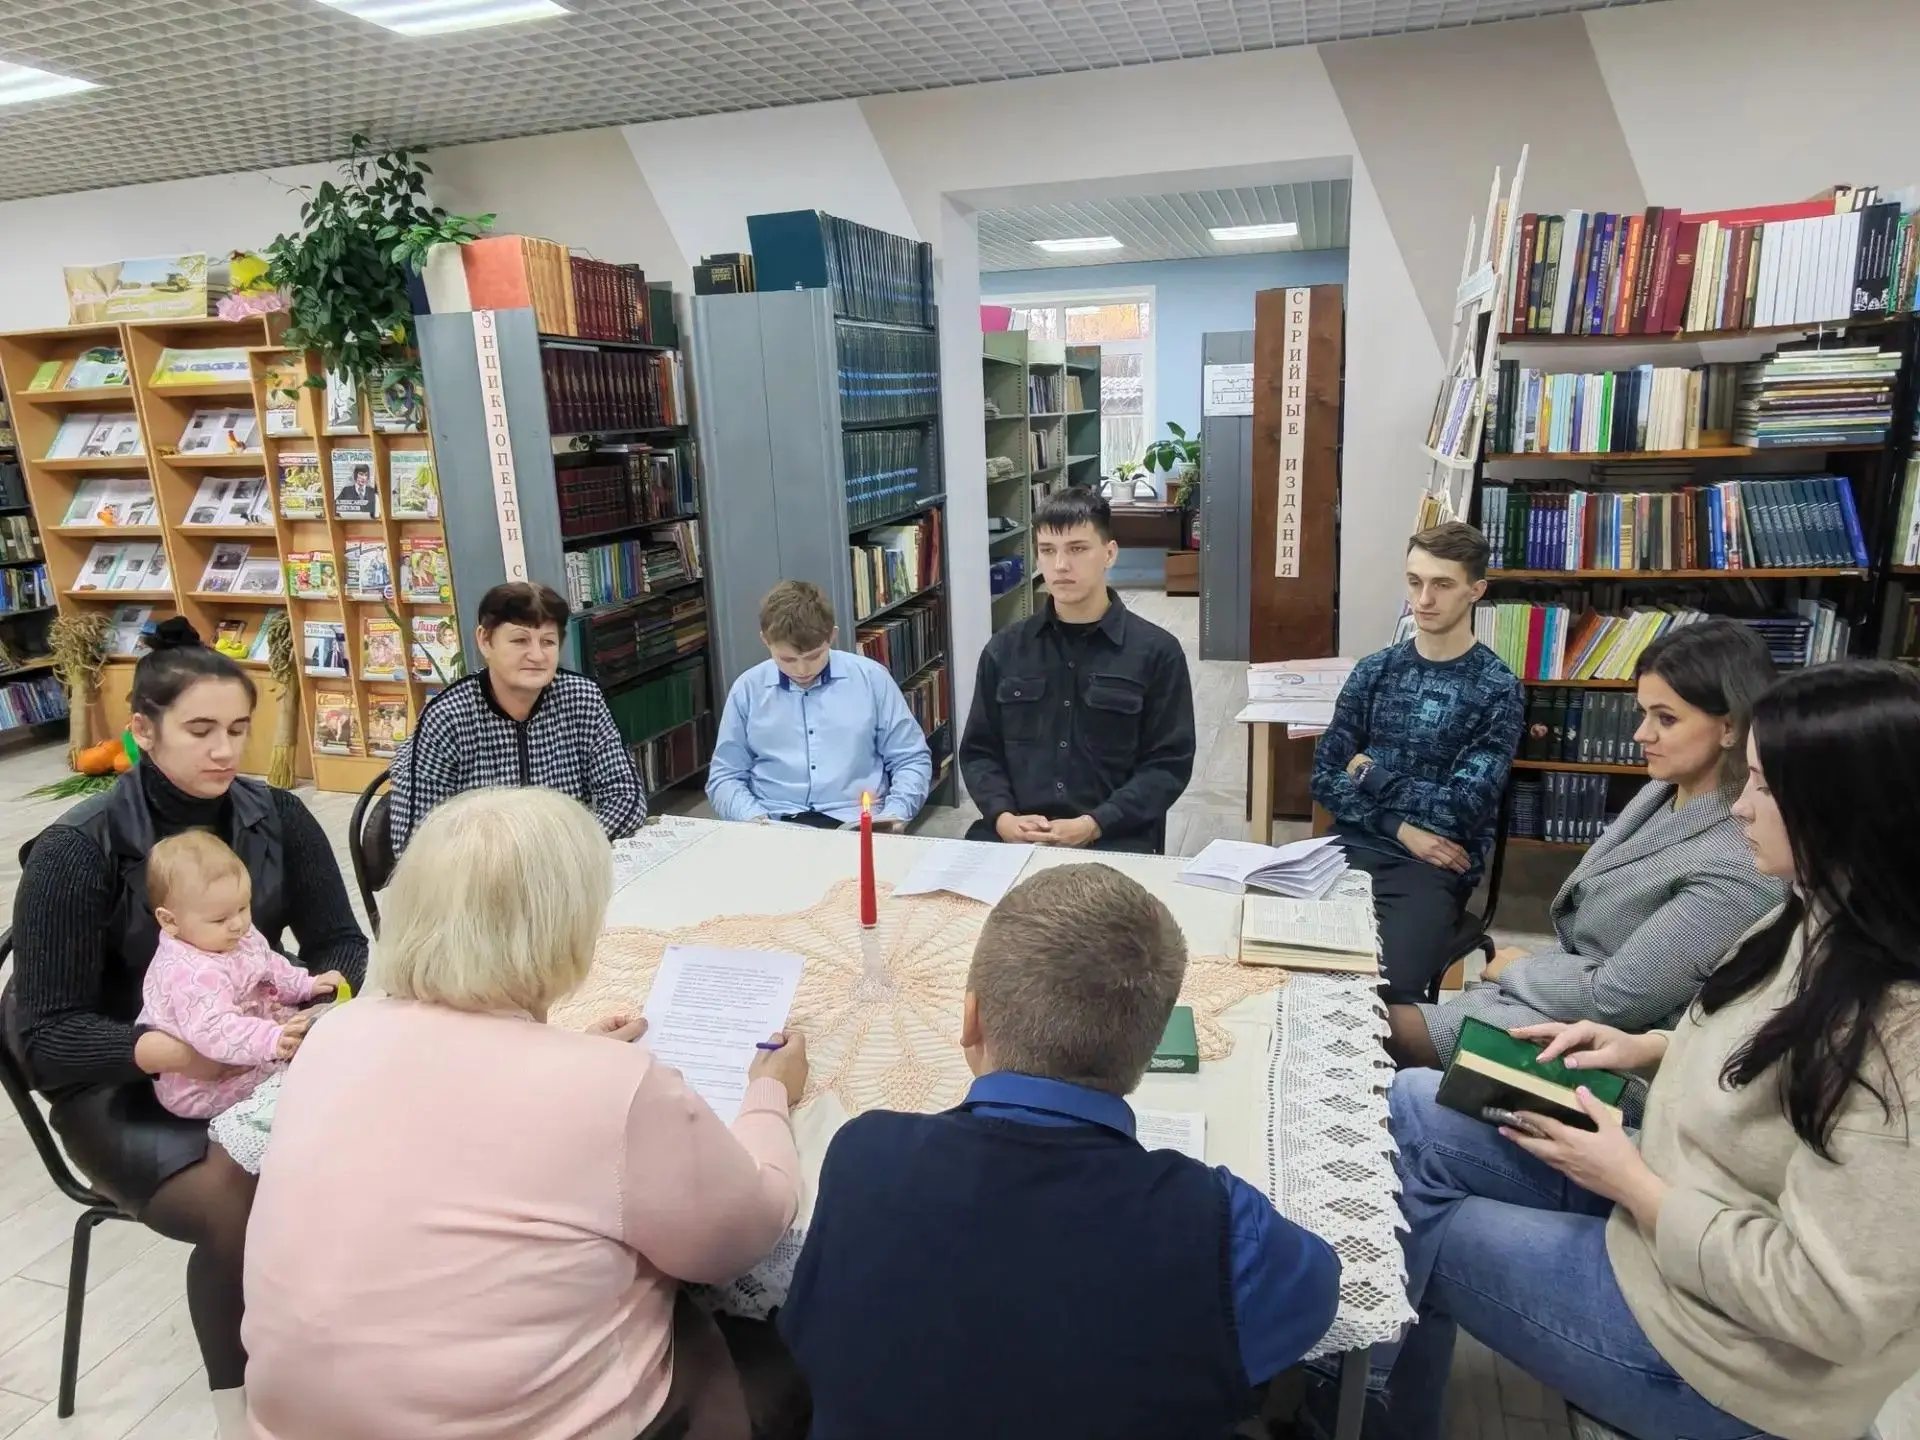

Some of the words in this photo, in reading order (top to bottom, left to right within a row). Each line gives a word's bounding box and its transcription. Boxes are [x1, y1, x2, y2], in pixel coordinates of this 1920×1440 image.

[481, 314, 520, 541] ЭНЦИКЛОПЕДИИ
[1285, 291, 1304, 435] СЕРИЙНЫЕ
[1281, 457, 1297, 576] ИЗДАНИЯ
